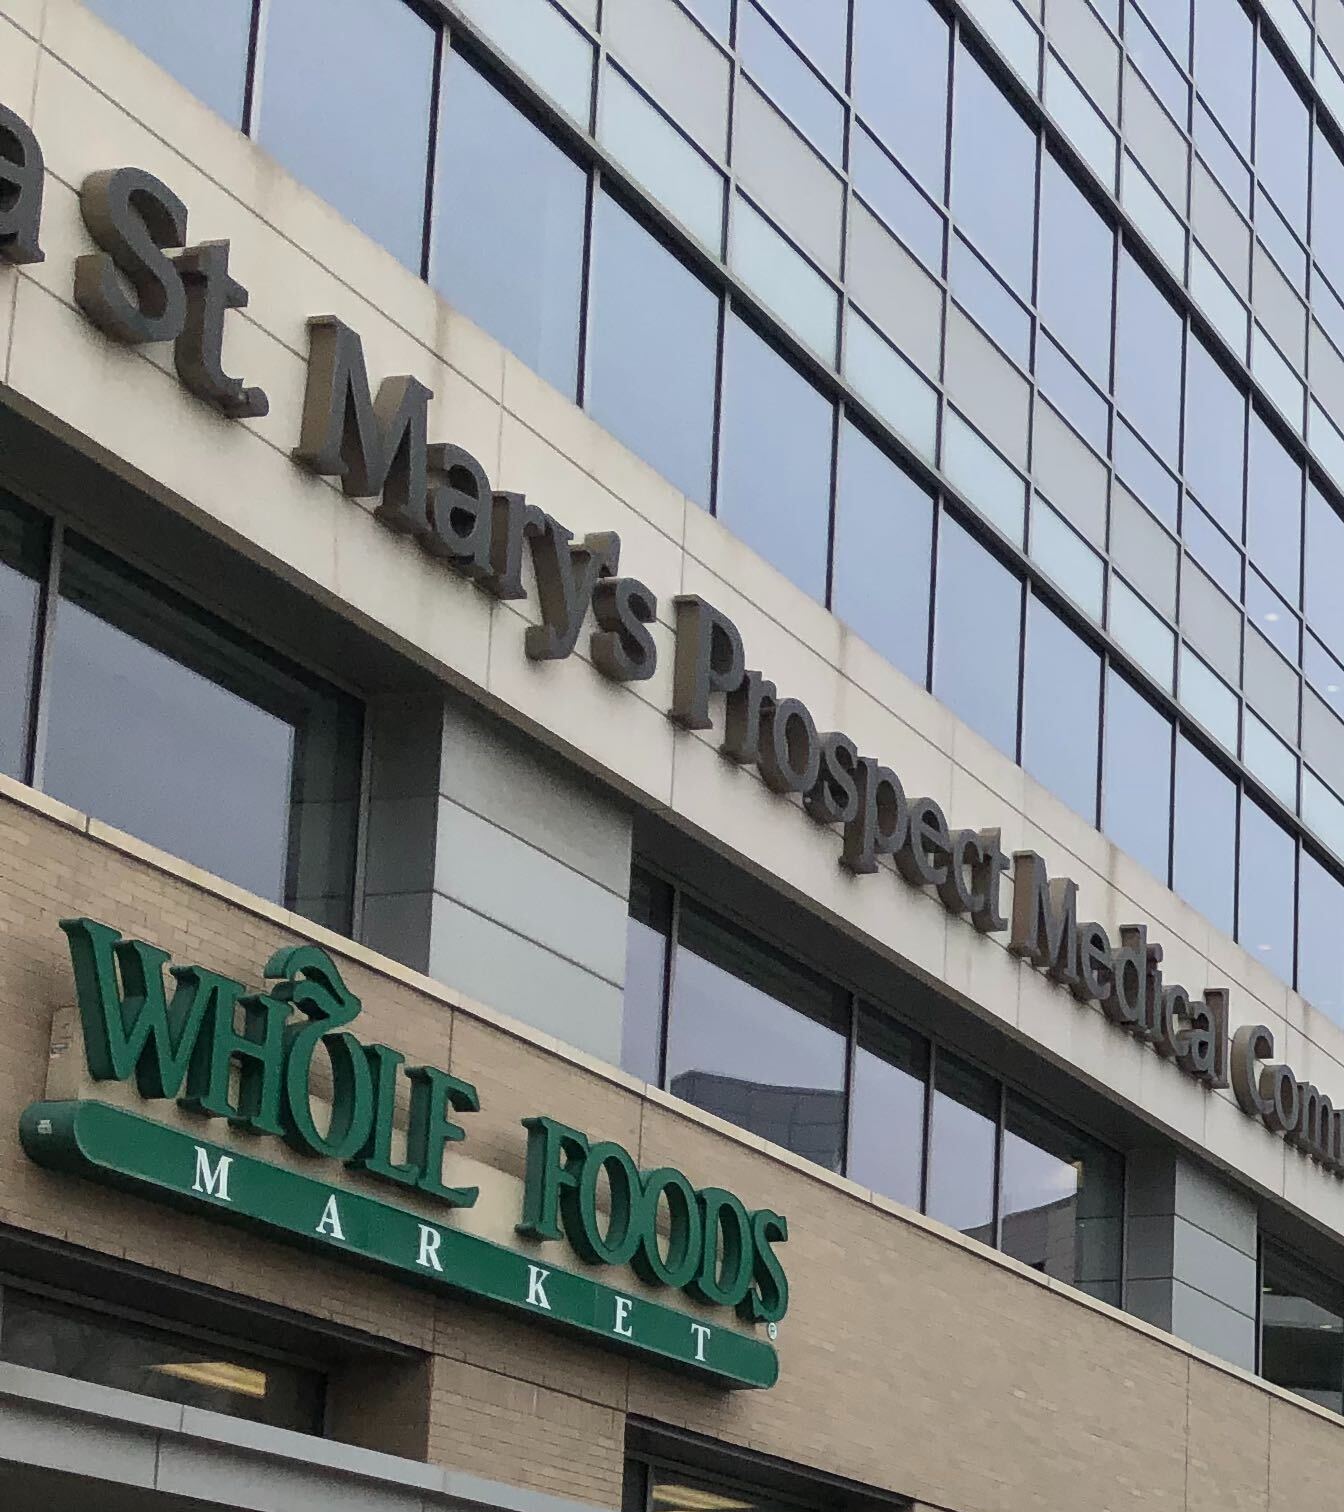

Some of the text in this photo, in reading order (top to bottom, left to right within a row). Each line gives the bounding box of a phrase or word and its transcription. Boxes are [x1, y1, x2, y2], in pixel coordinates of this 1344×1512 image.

[74, 167, 269, 418] St.
[292, 315, 656, 681] Mary's
[665, 593, 1010, 933] Prospect
[1008, 849, 1230, 1090] Medical
[58, 915, 789, 1324] WHOLE FOODS
[192, 1145, 712, 1363] MARKET
